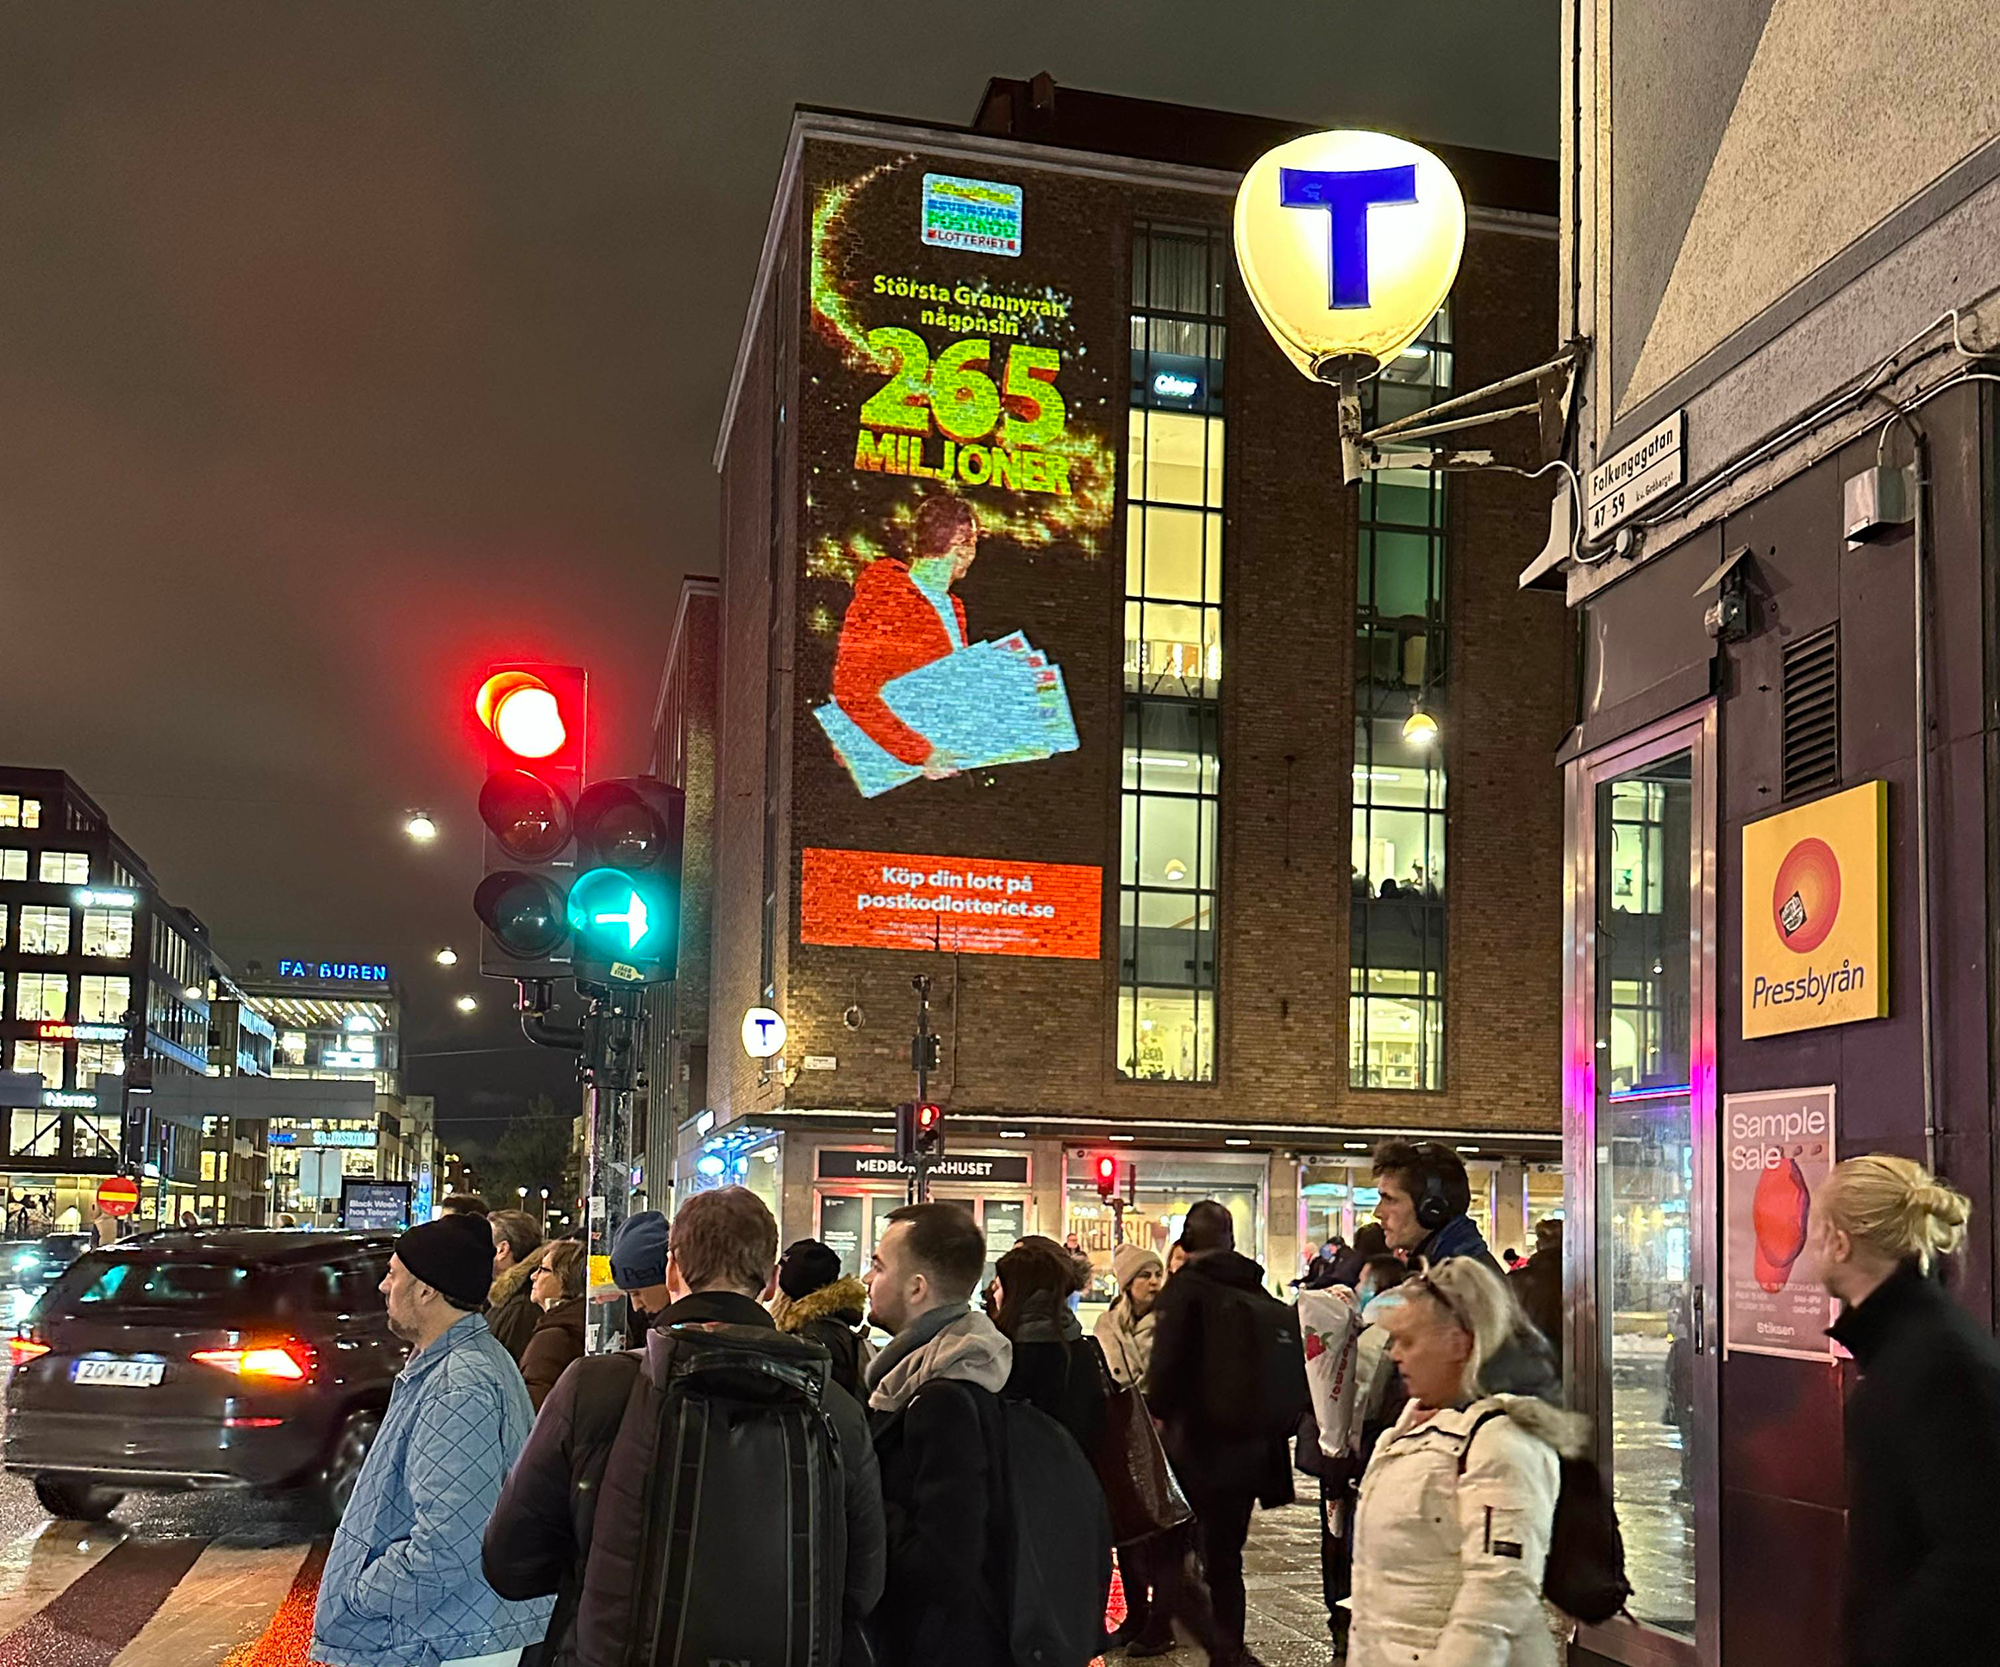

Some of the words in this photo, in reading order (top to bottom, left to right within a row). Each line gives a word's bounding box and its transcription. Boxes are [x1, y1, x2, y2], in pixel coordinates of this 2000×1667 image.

[938, 230, 1006, 248] LOTTERIET
[1280, 163, 1418, 310] T
[873, 274, 950, 302] Största
[921, 306, 1018, 336] någonsin
[860, 327, 1066, 446] 265
[854, 429, 1072, 496] MILJONER
[1593, 429, 1673, 496] Folkungagatan
[882, 866, 925, 888] Köp
[928, 869, 962, 888] din
[967, 871, 1003, 890] lott
[1007, 876, 1033, 894] på
[857, 894, 1056, 918] postkodlotteriet.se
[1752, 959, 1865, 1009] Pressbyrån
[755, 1019, 775, 1046] T
[1732, 1106, 1825, 1142] Sample
[856, 1159, 992, 1175] MEDBOARHUSET
[1731, 1142, 1781, 1171] Sale
[349, 1208, 366, 1216] hos
[367, 1208, 398, 1217] Telenor
[350, 1200, 373, 1208] Black
